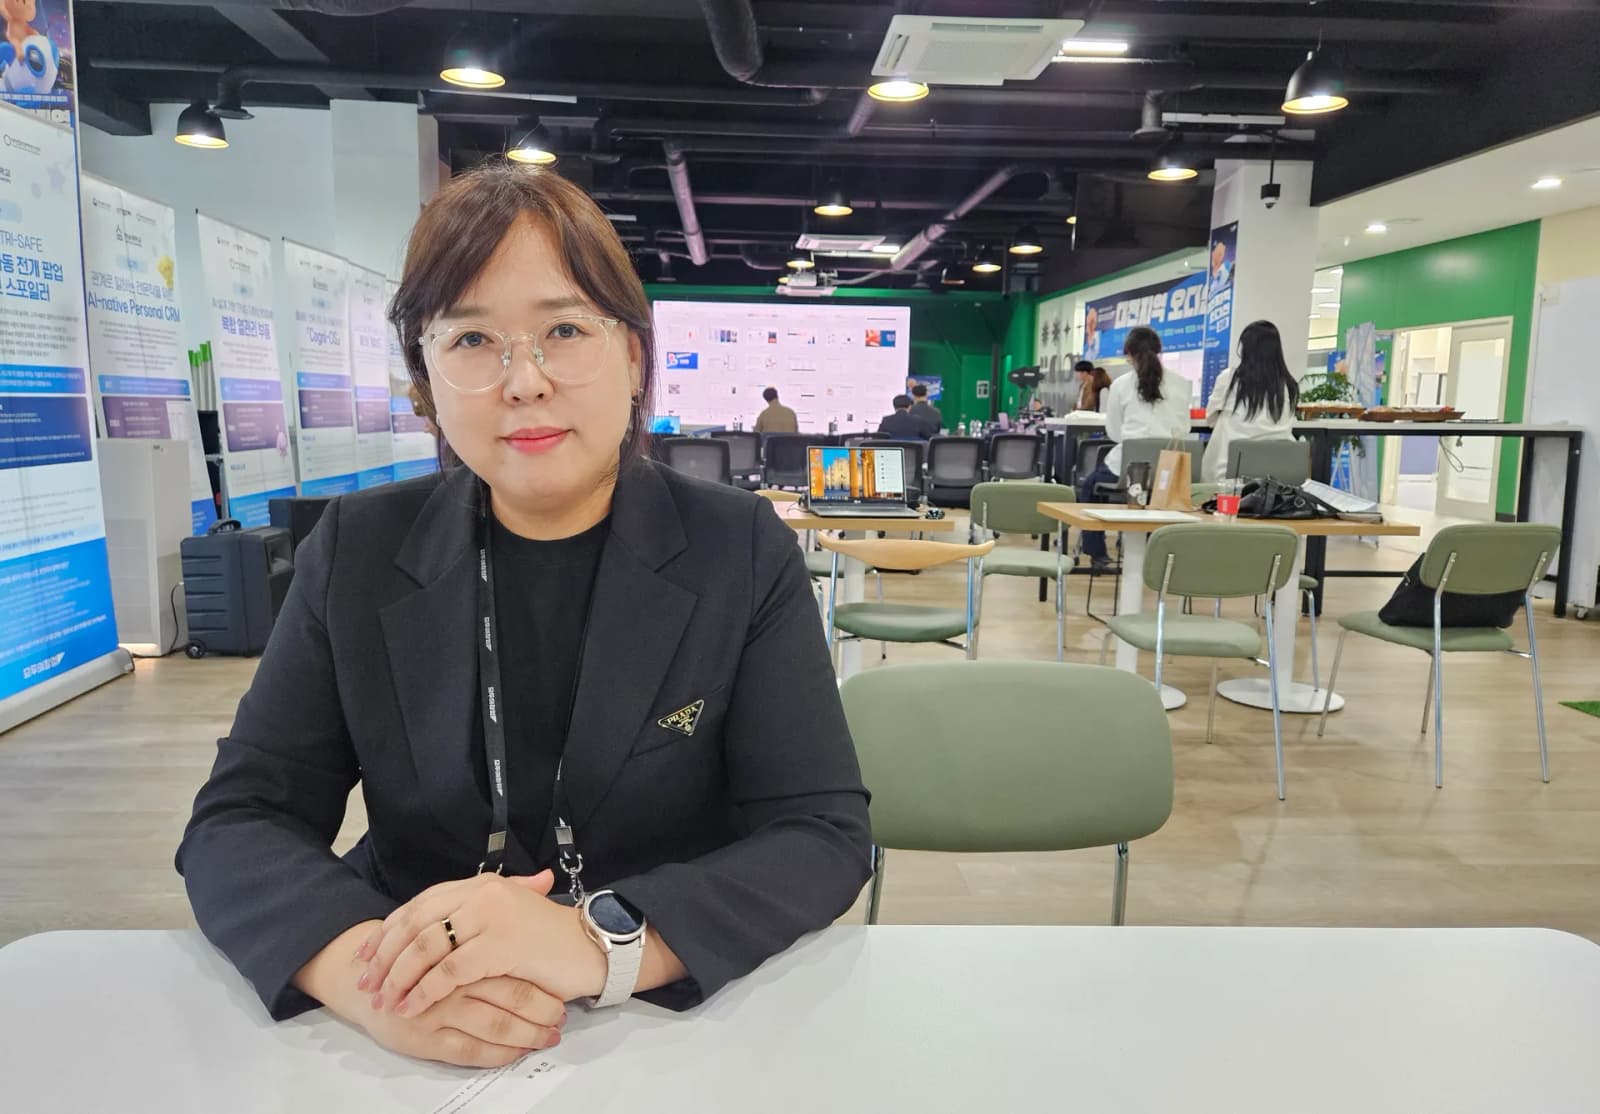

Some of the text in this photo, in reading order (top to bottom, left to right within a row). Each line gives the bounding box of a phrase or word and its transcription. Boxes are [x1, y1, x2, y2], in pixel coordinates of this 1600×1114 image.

[16, 255, 40, 278] 전개
[41, 260, 64, 282] 팝업
[5, 277, 50, 302] 스포일러
[87, 289, 181, 324] AI-native Personal CRM
[666, 706, 698, 725] PRADA
